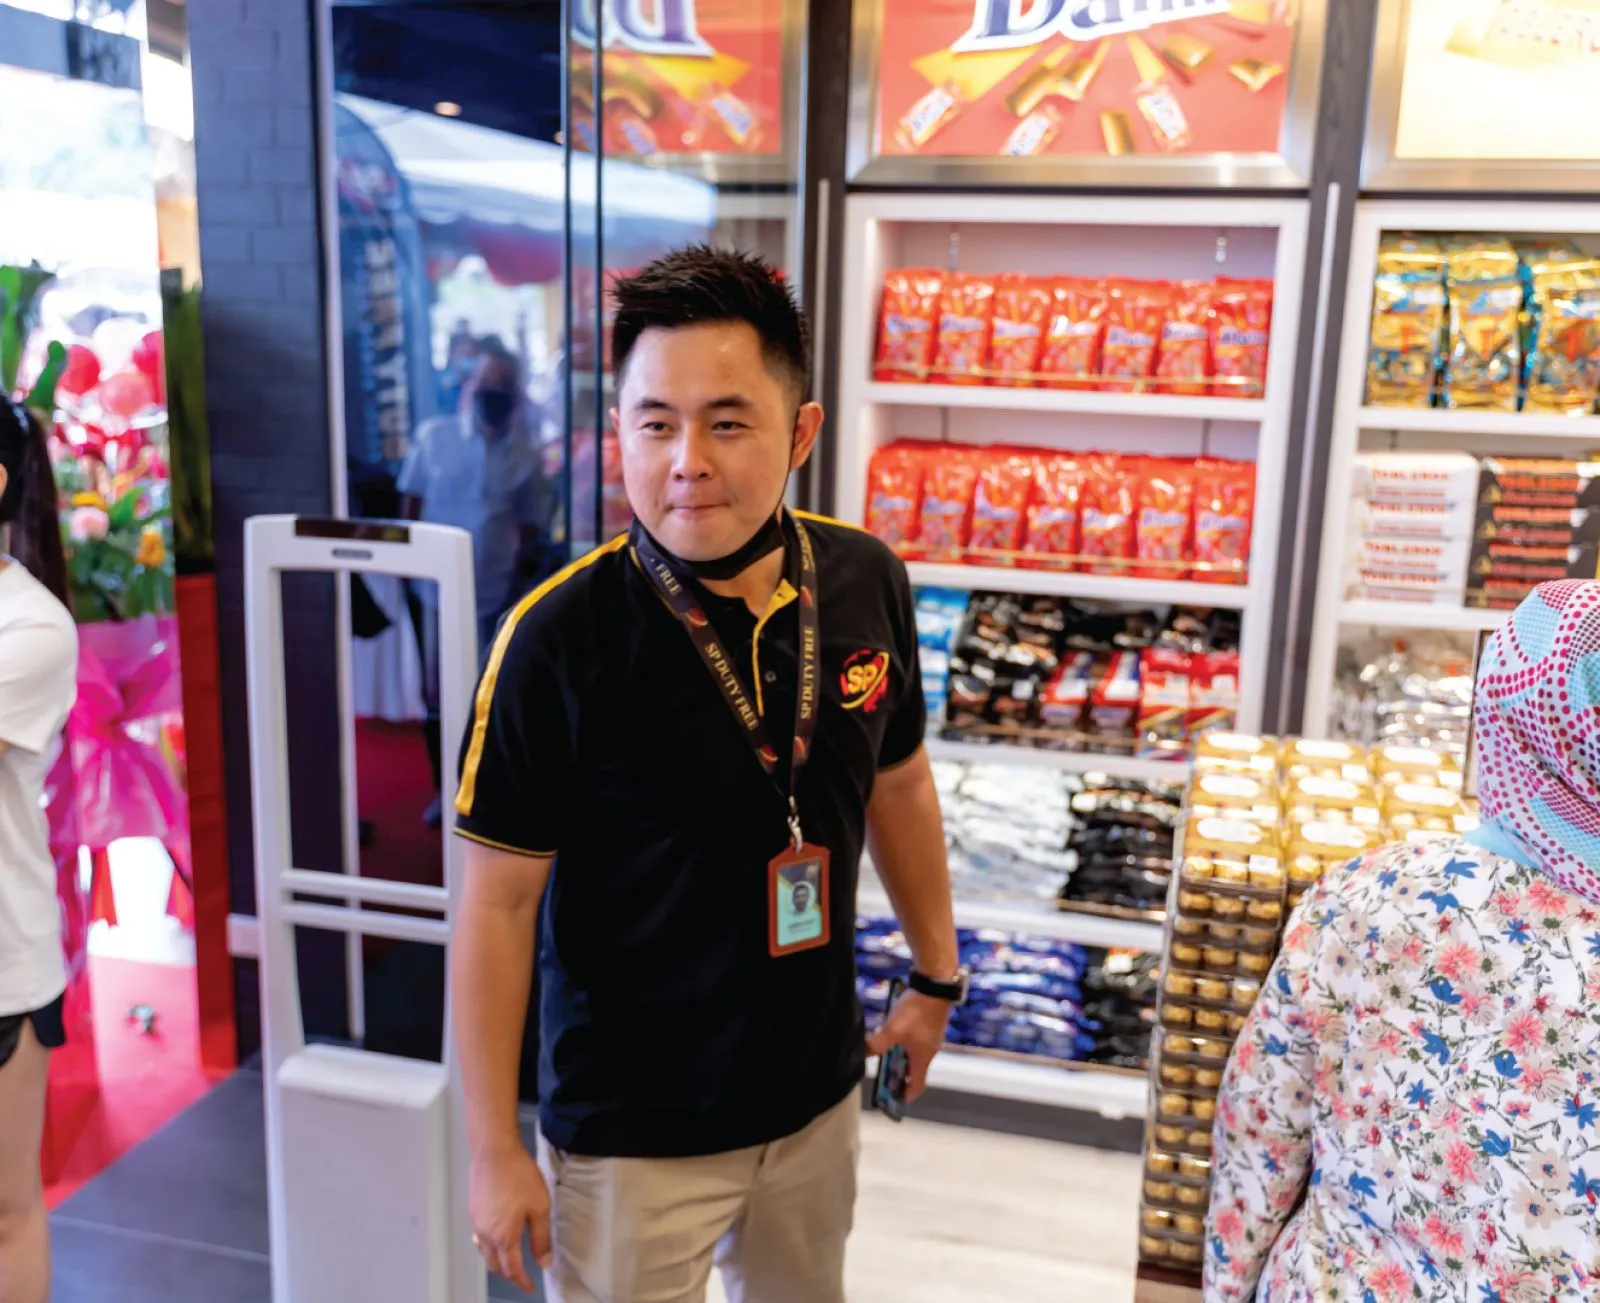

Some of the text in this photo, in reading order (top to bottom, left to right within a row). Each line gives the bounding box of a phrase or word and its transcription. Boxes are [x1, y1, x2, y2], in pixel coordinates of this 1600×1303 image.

[654, 562, 683, 597] FREE
[705, 642, 760, 732] SP DUTY FREE
[800, 626, 816, 720] SP DUTY FREE
[846, 664, 879, 695] SP
